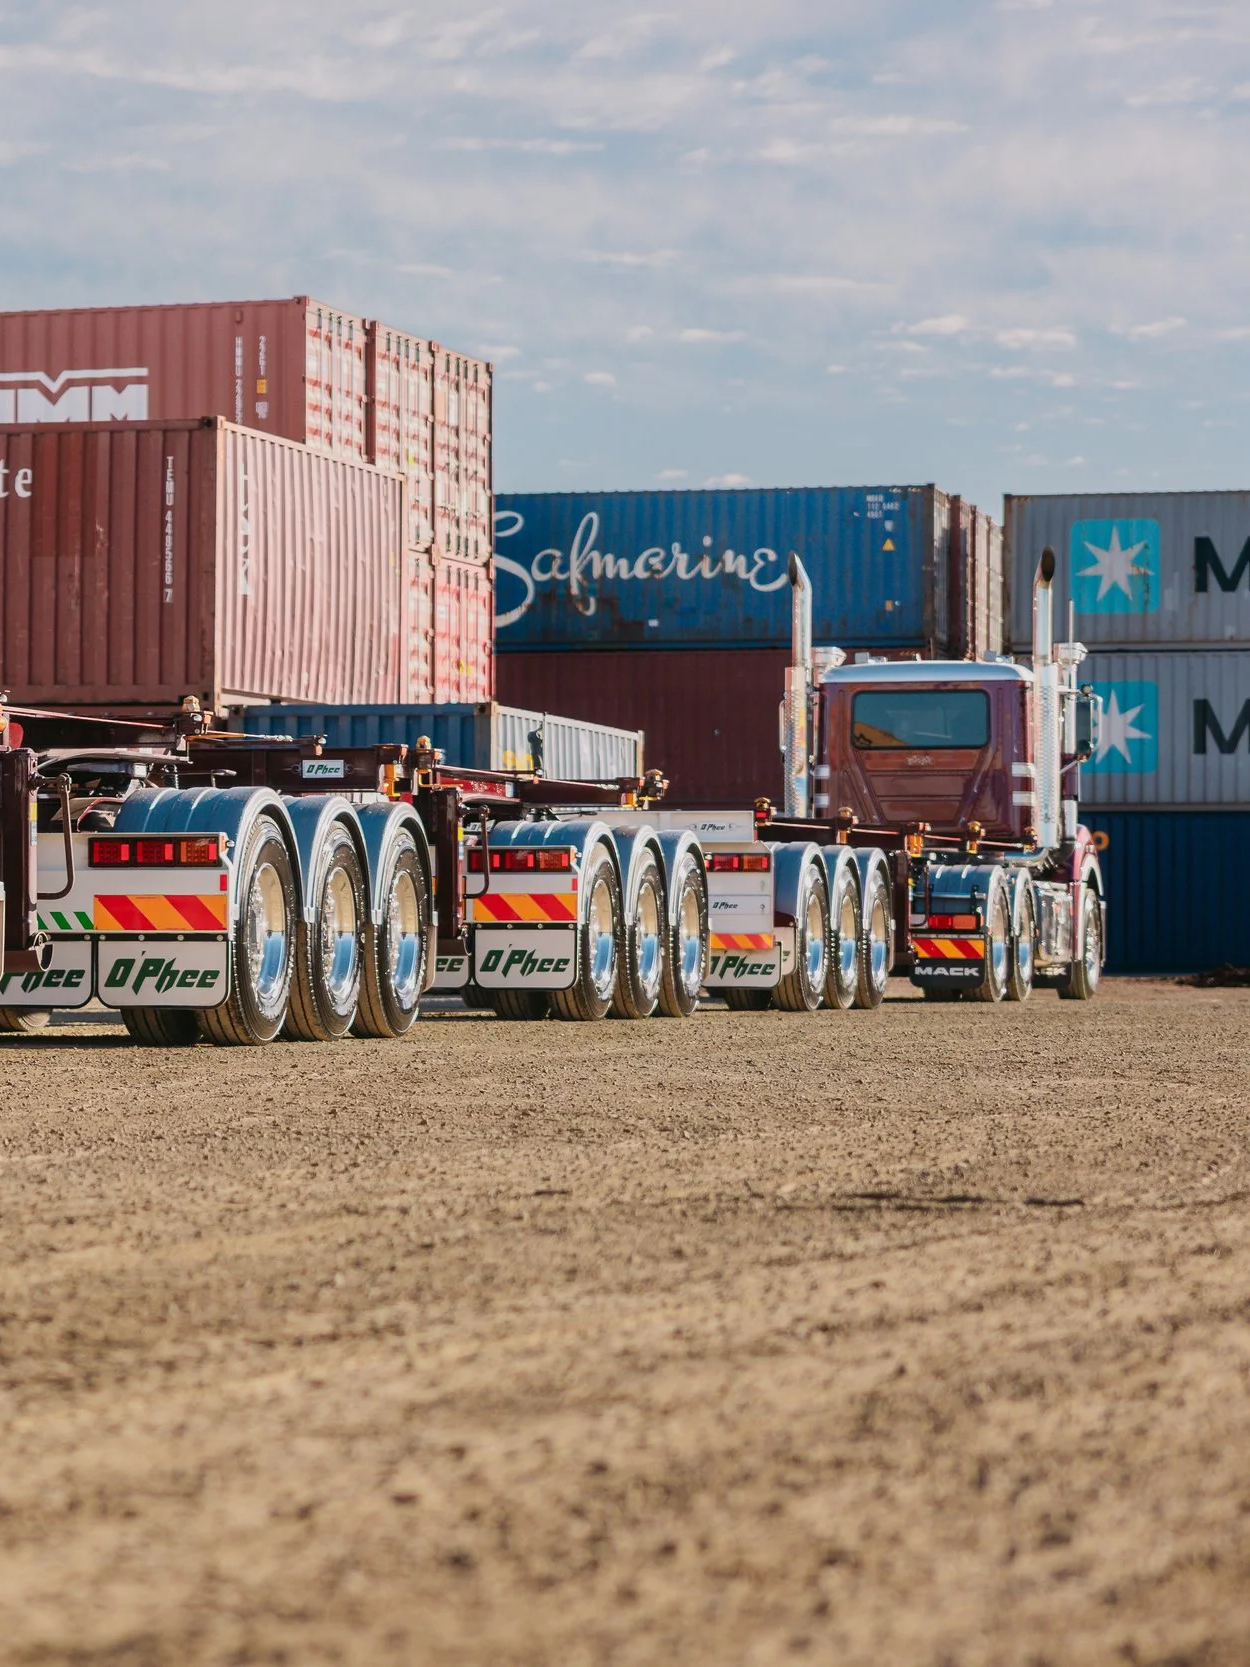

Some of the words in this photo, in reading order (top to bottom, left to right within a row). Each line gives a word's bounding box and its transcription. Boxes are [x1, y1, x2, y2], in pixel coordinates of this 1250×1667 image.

[494, 511, 788, 627] Safmarine
[1194, 536, 1250, 592] M
[306, 763, 341, 774] OPhee
[104, 951, 220, 995] O'Phee
[480, 944, 570, 978] O'Phee
[914, 967, 980, 976] MACK
